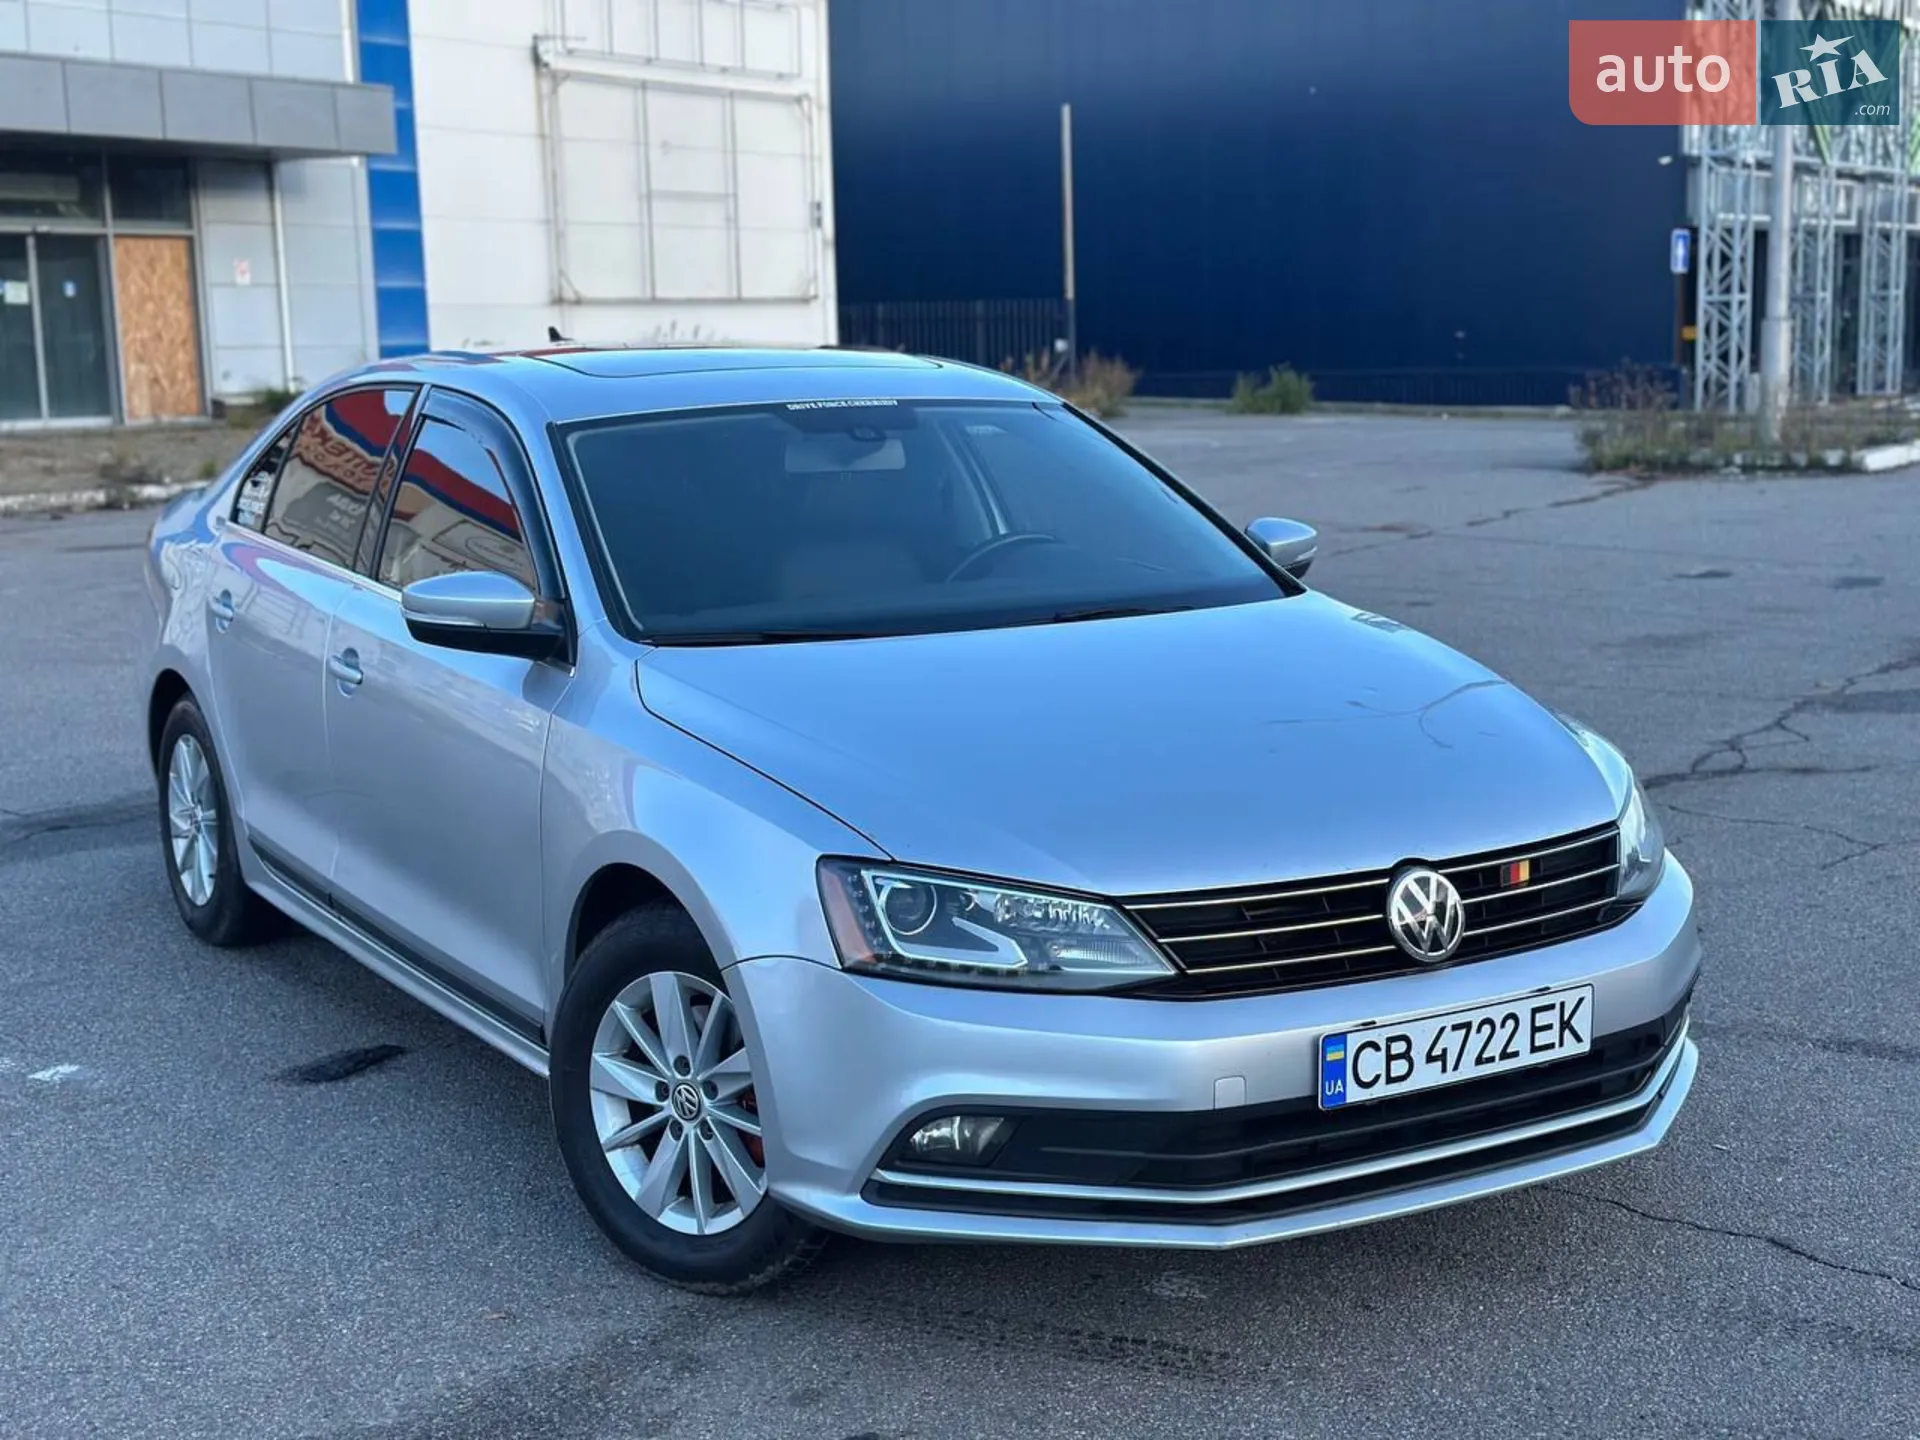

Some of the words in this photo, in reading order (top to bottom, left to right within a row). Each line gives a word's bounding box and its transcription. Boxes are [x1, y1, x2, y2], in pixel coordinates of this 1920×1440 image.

[1352, 1034, 1414, 1090] CB
[1425, 1012, 1521, 1074] 4722
[1529, 996, 1586, 1054] EK
[1325, 1079, 1344, 1096] UA
